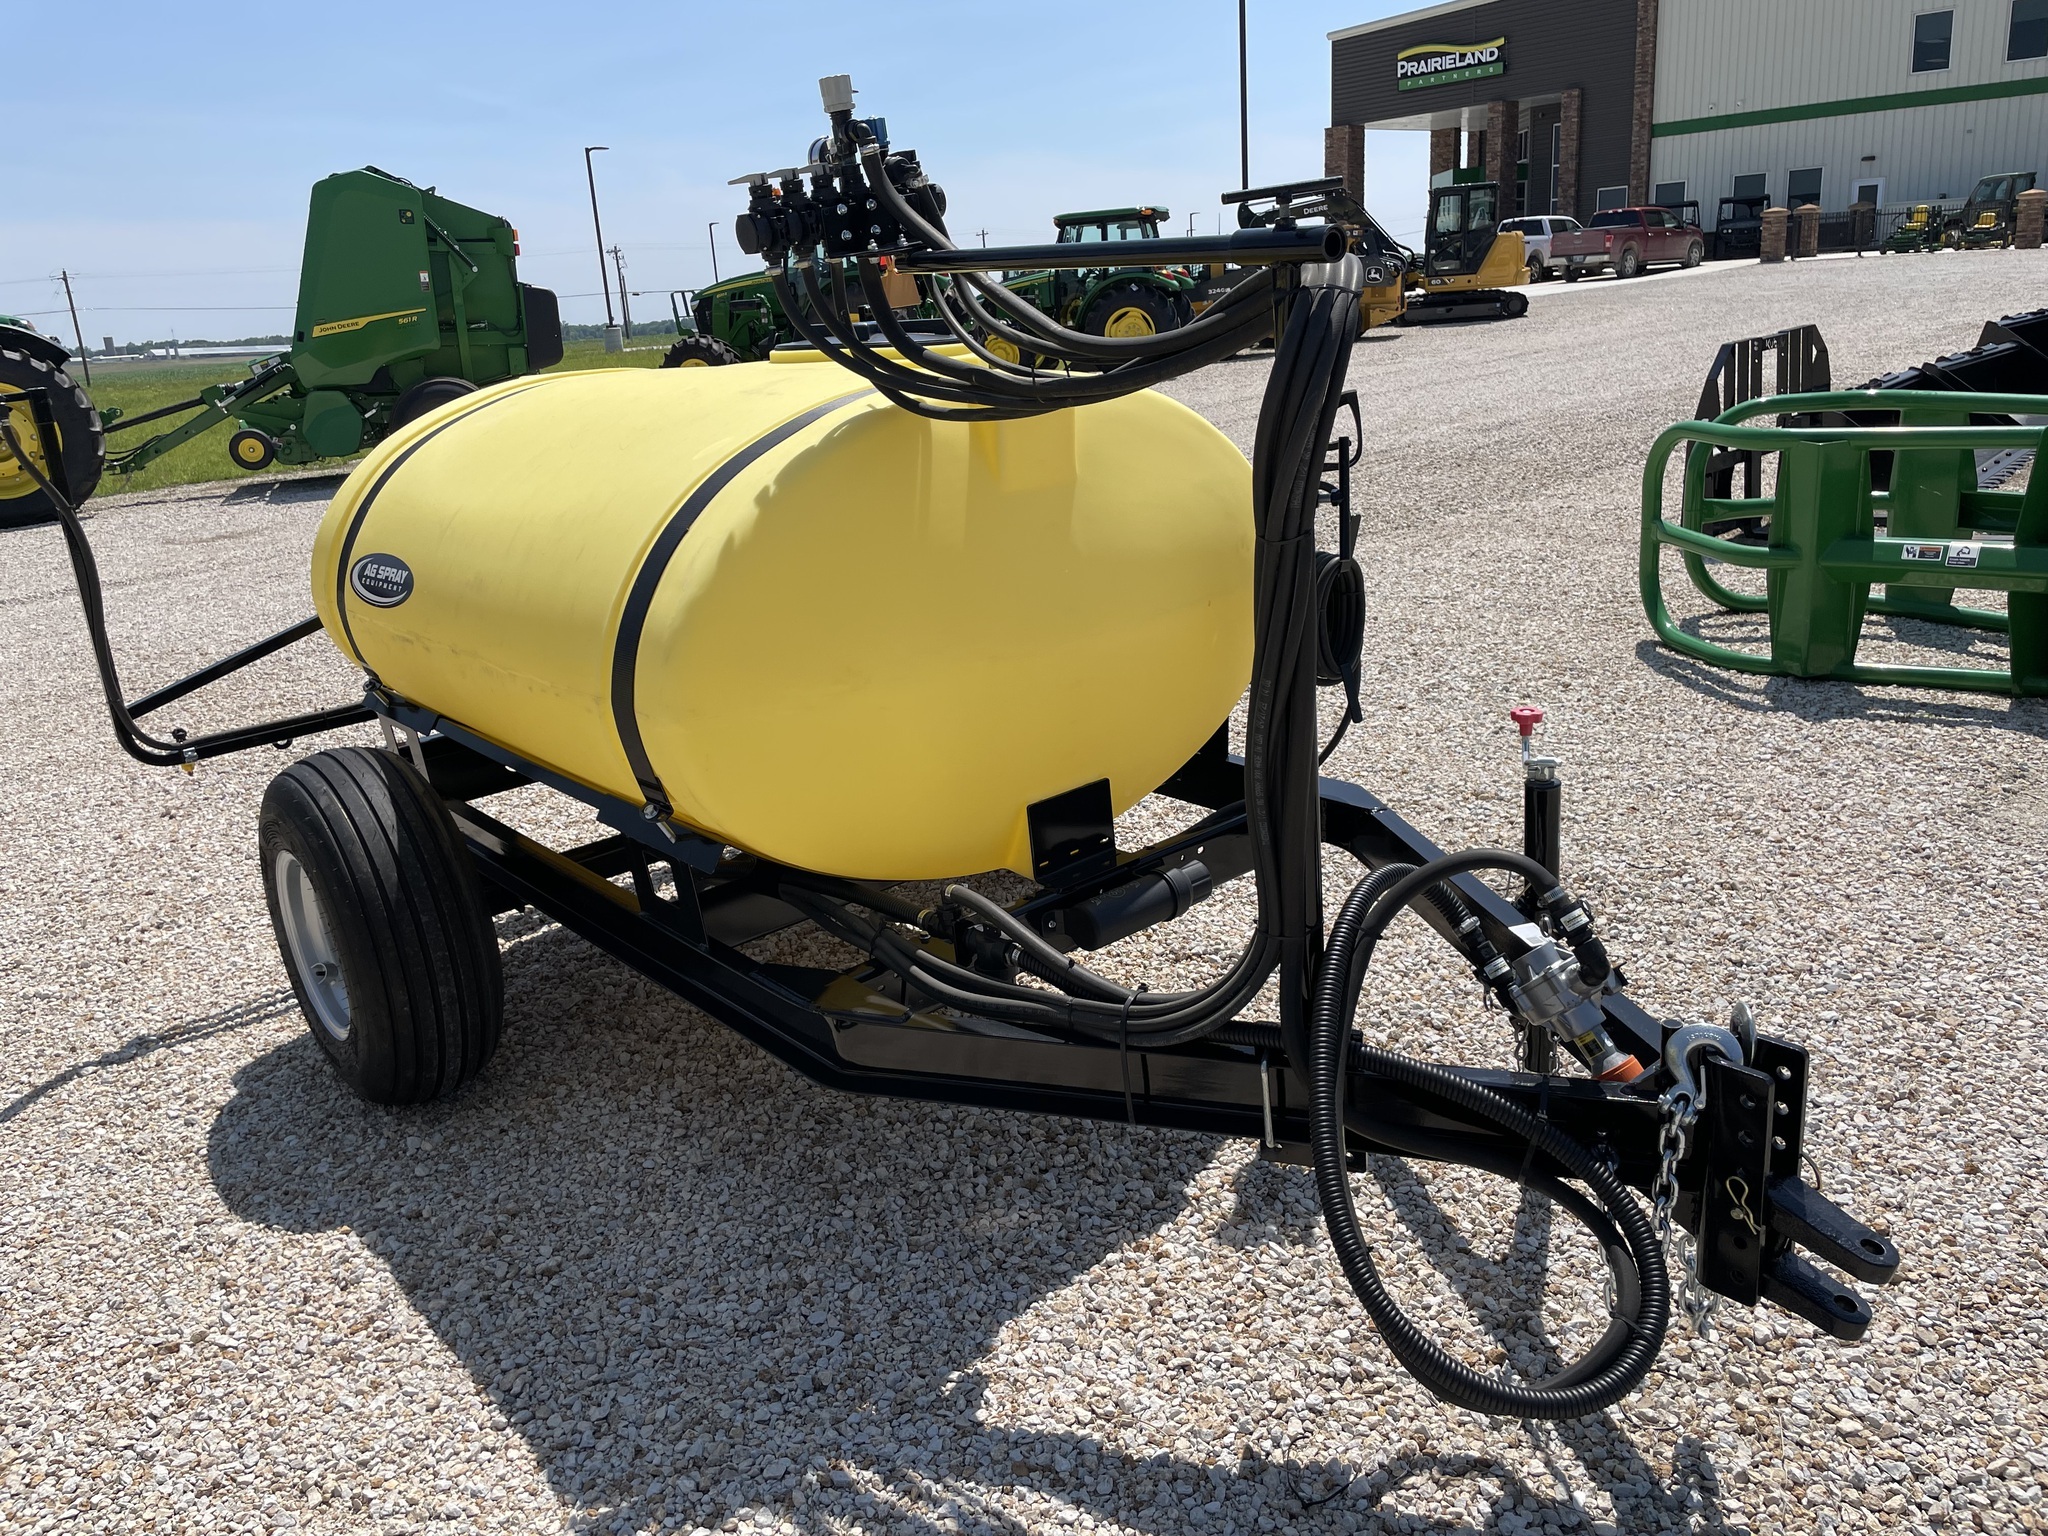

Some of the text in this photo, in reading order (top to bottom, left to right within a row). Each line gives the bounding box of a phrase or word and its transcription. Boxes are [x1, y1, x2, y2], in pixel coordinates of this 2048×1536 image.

[1397, 47, 1499, 78] PRAIRIELAND
[1407, 66, 1494, 87] PARTNERS
[1303, 204, 1329, 215] DEERE
[337, 321, 360, 330] DEERE
[363, 563, 409, 584] AG SPRAY
[361, 577, 402, 592] EQUIPMENT
